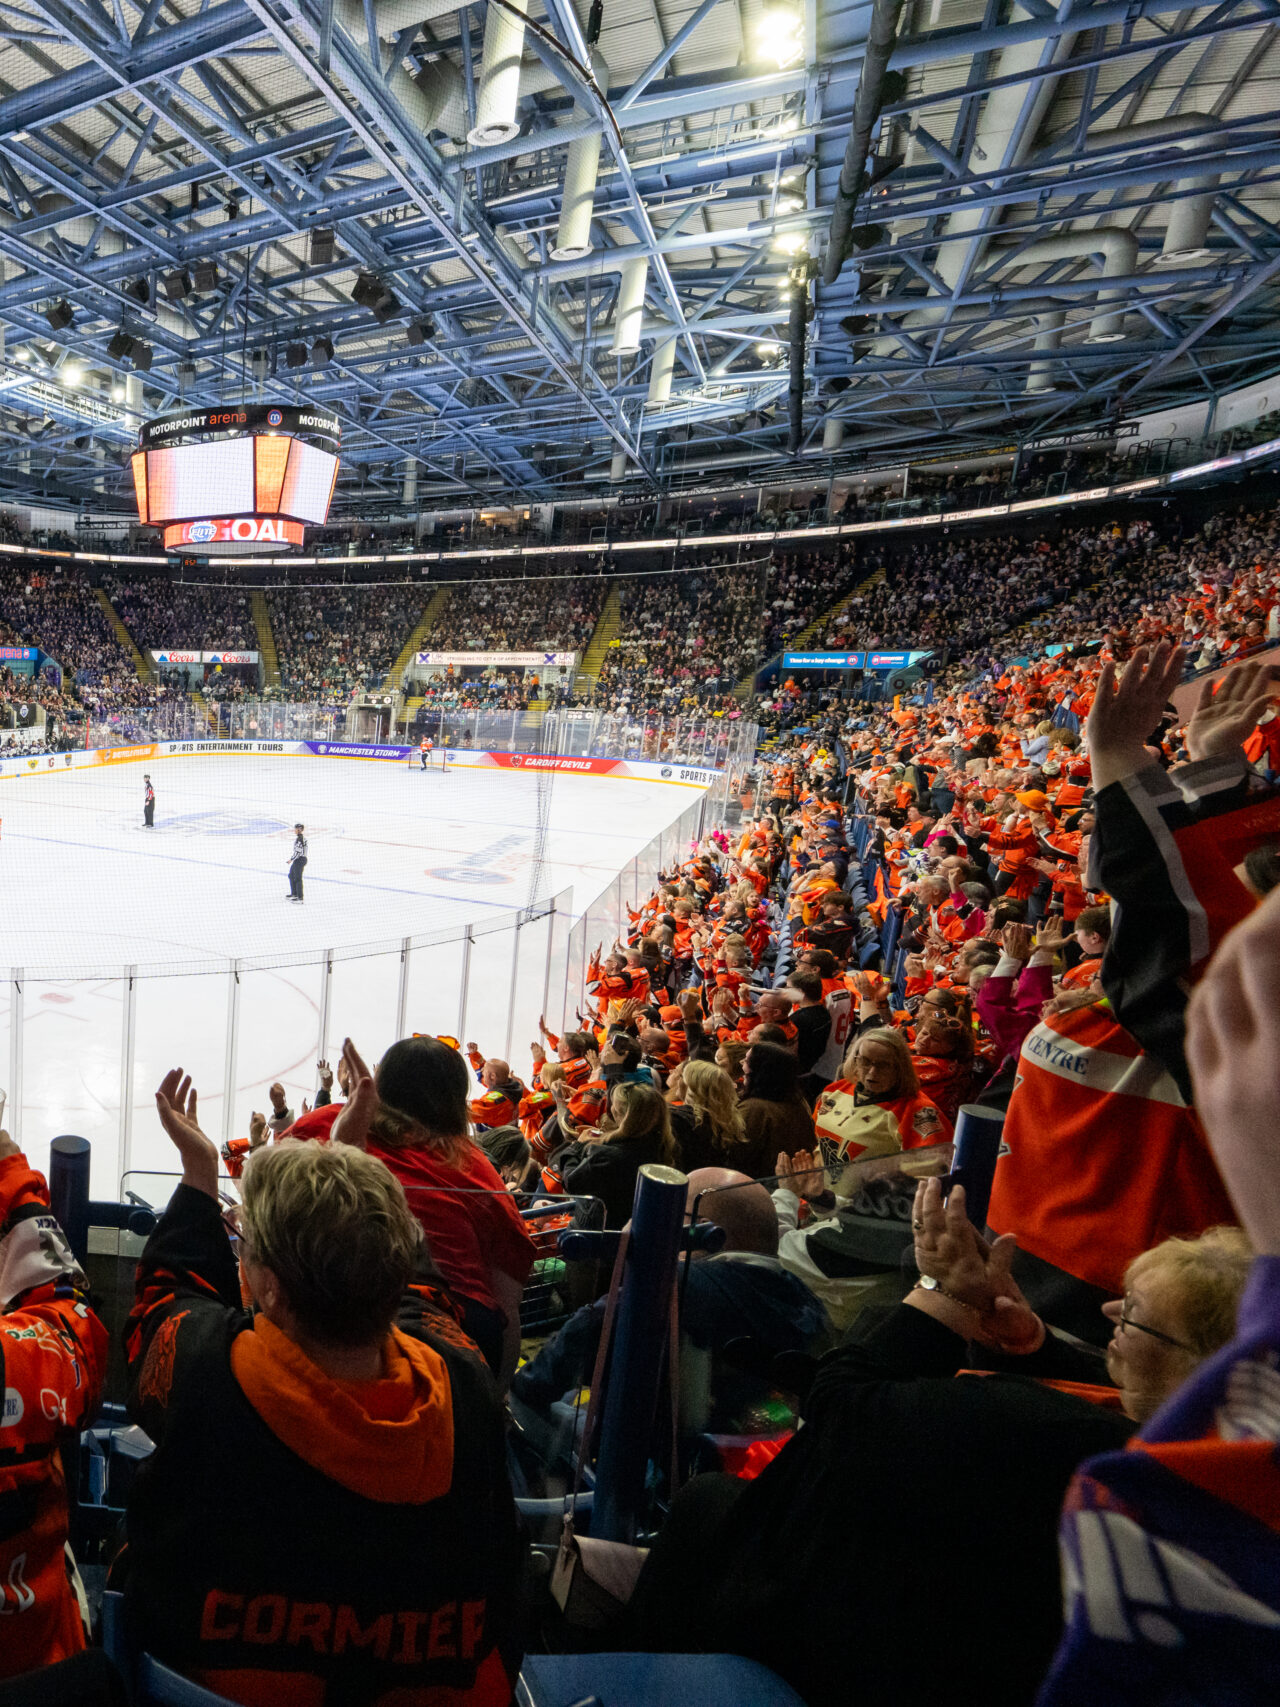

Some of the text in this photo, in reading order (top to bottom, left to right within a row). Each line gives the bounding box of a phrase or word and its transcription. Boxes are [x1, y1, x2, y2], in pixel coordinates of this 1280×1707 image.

[149, 411, 248, 438] MOTORPOINT arena
[169, 651, 195, 663] Coors
[222, 651, 251, 664] Coors
[197, 743, 253, 751] ENTERTAINMENT
[257, 743, 284, 751] TOURS
[328, 746, 401, 758] MANCHESTER STORM
[524, 757, 593, 770] CARDIFF DEVILS
[680, 769, 707, 783] SPORTS
[1028, 1035, 1089, 1076] CENTRE
